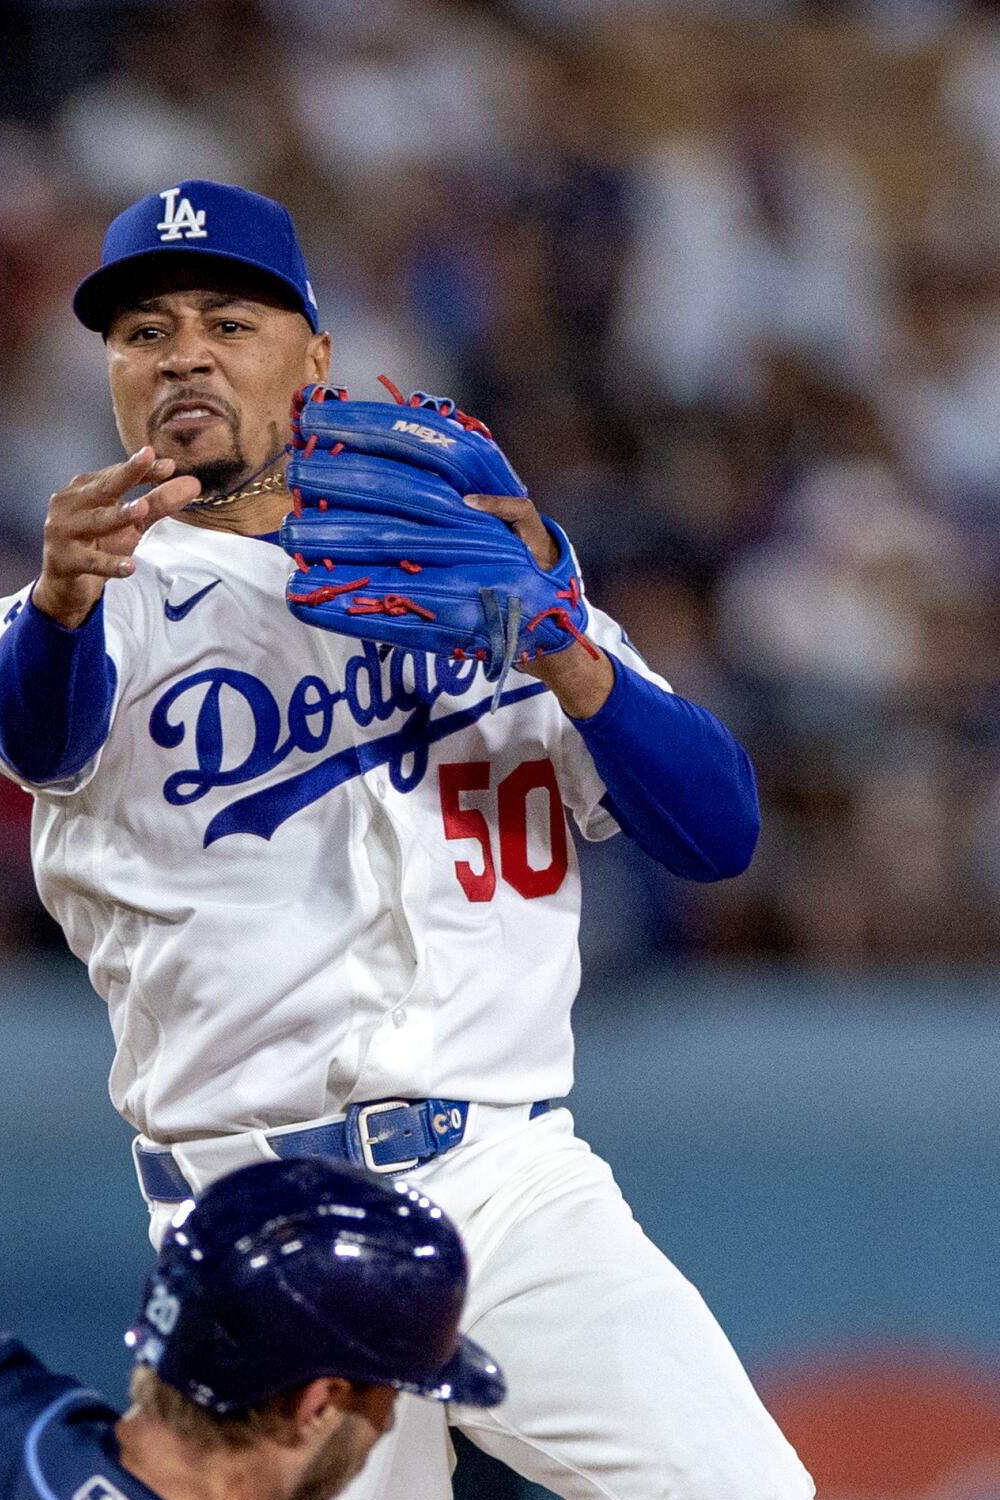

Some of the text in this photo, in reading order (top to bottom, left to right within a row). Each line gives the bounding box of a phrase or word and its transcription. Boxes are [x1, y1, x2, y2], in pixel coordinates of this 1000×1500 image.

[157, 187, 208, 241] LA
[149, 638, 502, 806] Dodge
[438, 757, 569, 903] 50
